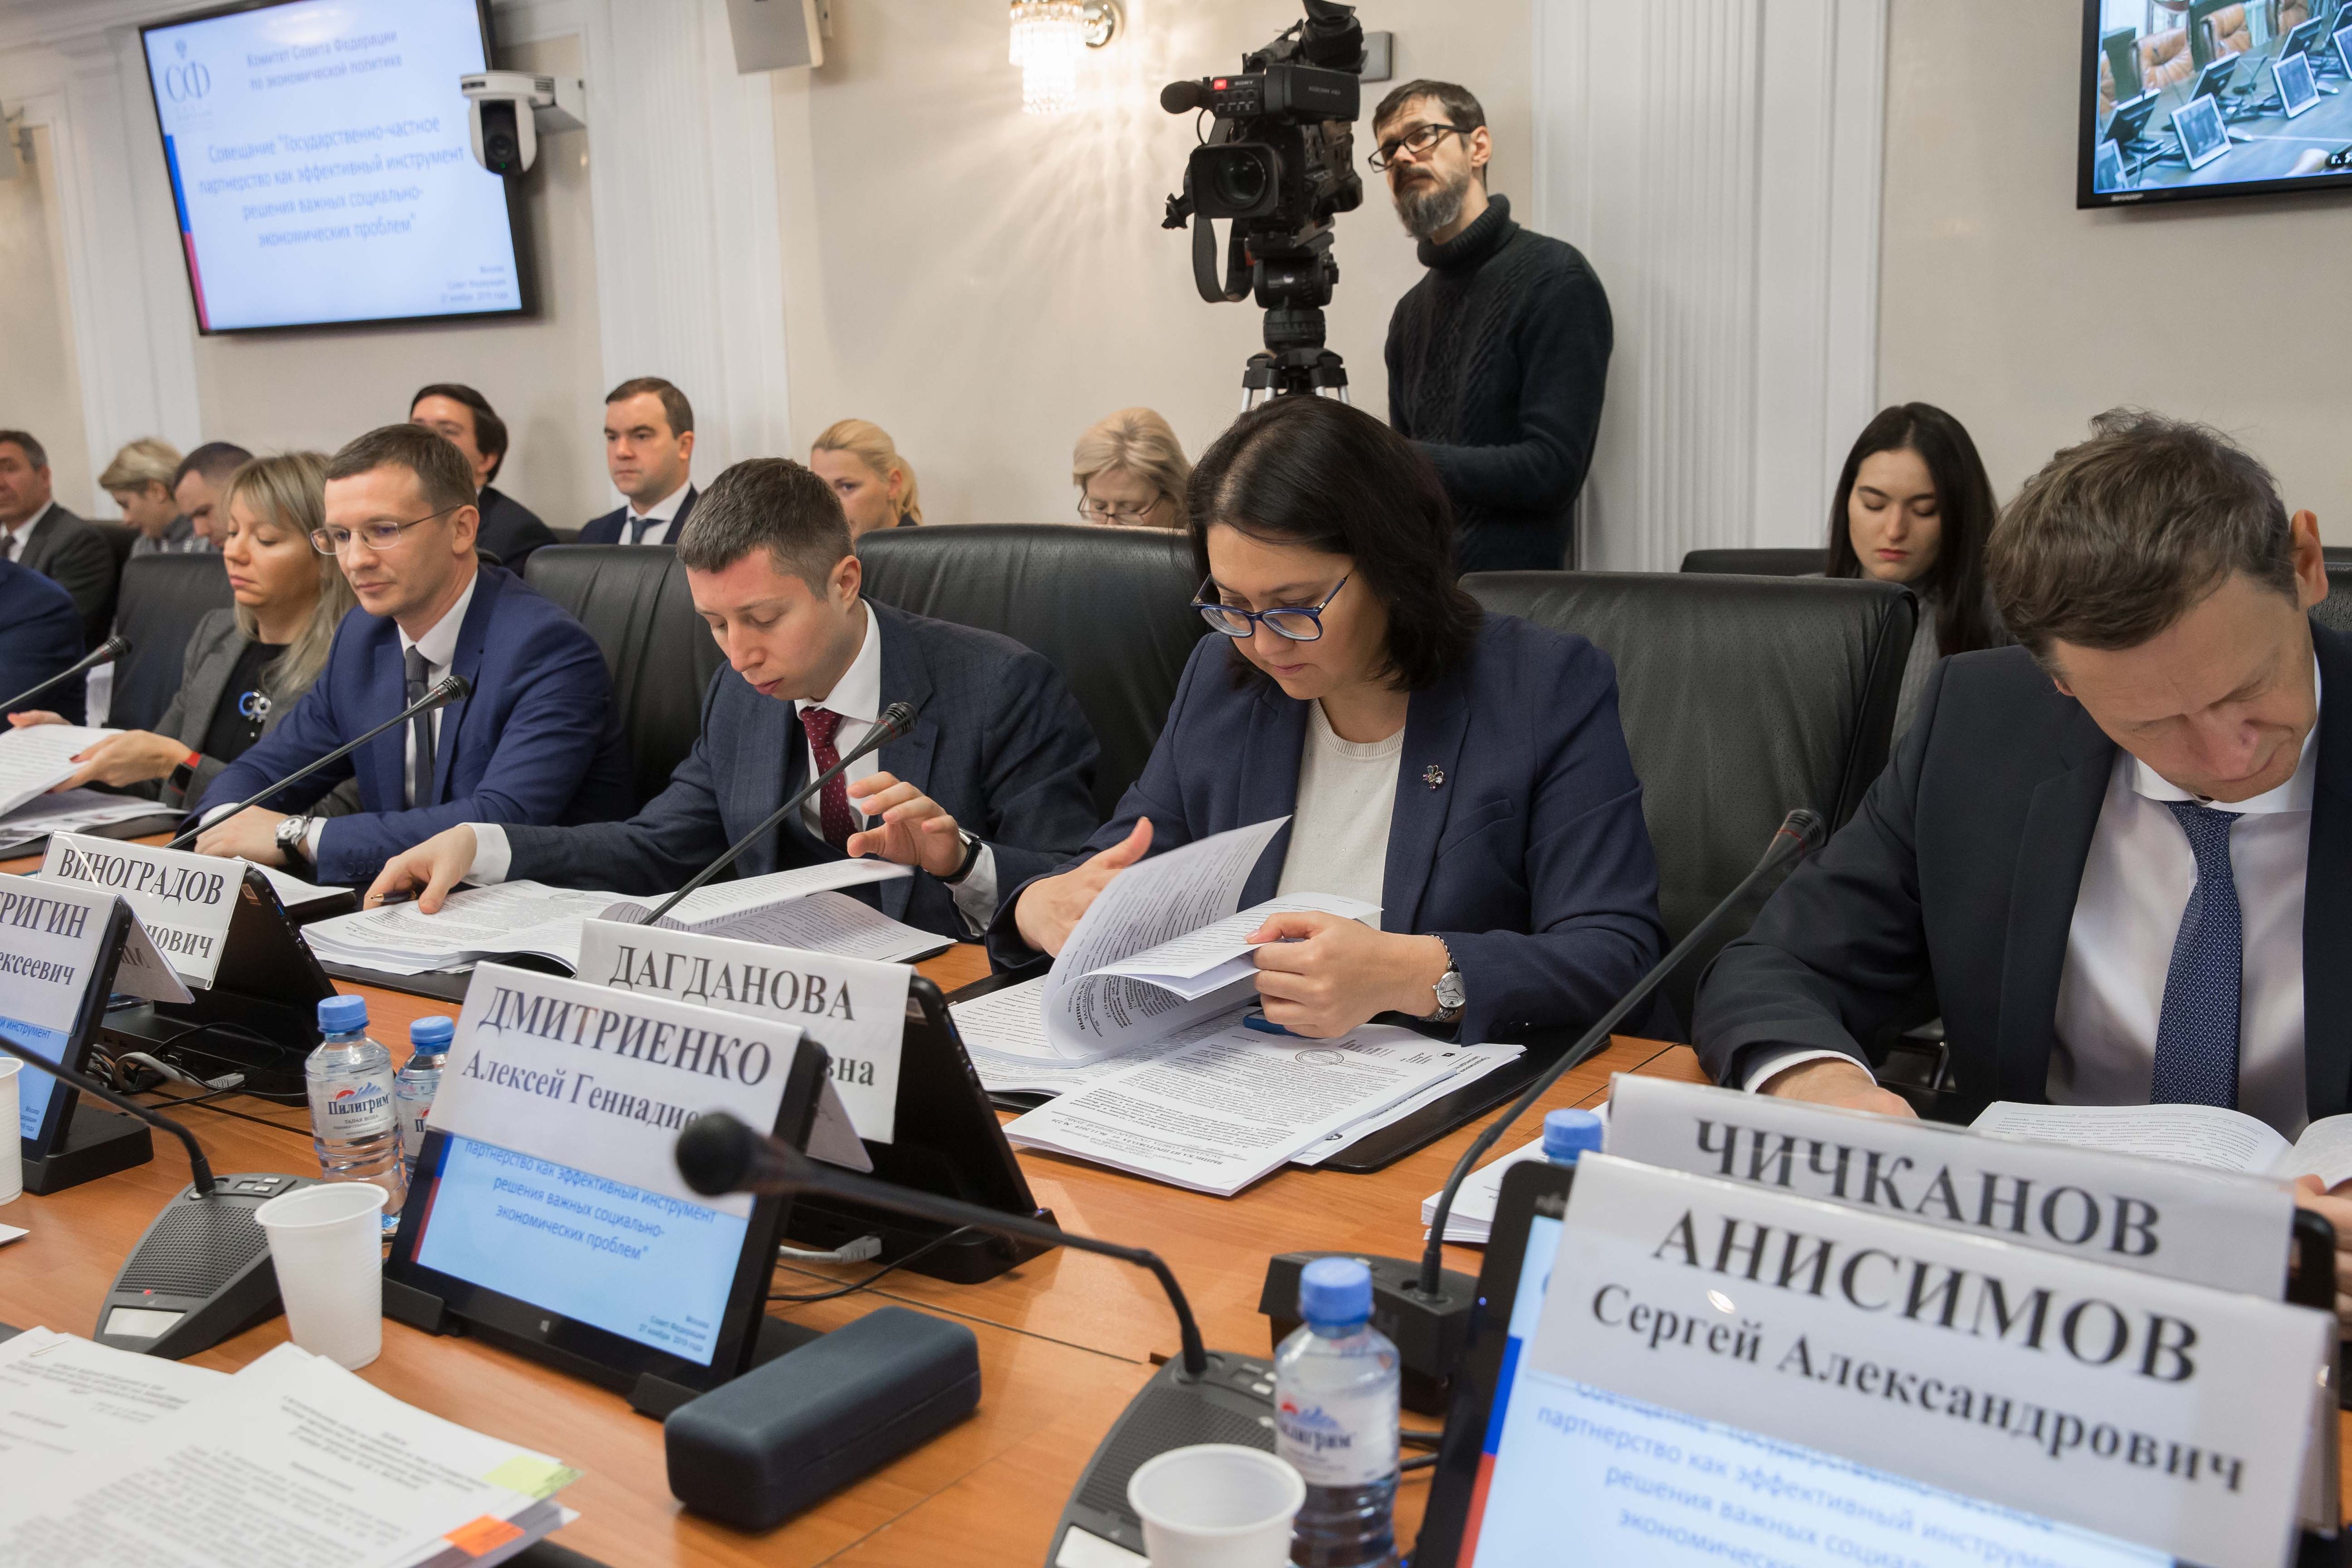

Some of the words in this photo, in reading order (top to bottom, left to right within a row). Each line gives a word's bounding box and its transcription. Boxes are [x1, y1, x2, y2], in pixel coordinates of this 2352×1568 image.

[267, 63, 348, 89] экономической
[199, 172, 272, 195] партнерство
[275, 168, 295, 183] как
[298, 154, 384, 183] эффективный
[387, 147, 464, 171] инструмент
[207, 141, 276, 163] Совещание
[242, 199, 296, 221] решения
[300, 195, 347, 214] важных
[259, 226, 351, 247] экономических
[57, 848, 225, 907] ВИНОГРАДОВ
[0, 891, 92, 939] РИГИН
[146, 924, 215, 958] нович
[609, 945, 856, 1022] ДАГДАНОВА
[7, 1023, 52, 1039] инструмент
[477, 987, 772, 1087] ДМИТРИЕНКО
[328, 1095, 389, 1115] Пилигрим
[461, 1048, 566, 1100] Алексей
[569, 1075, 699, 1130] Геннадие
[465, 1141, 533, 1171] партнерство
[536, 1162, 555, 1178] как
[557, 1165, 639, 1202] эффективный
[641, 1192, 716, 1224] инструмент
[493, 1177, 544, 1202] решения
[547, 1192, 592, 1217] важных
[594, 1207, 665, 1238] социально-
[1696, 1117, 2161, 1259] ЧИЧКАНОВ
[496, 1205, 584, 1242] экономических
[587, 1232, 648, 1261] проблем"
[1652, 1208, 2199, 1385] АНИСИМОВ
[1592, 1281, 1764, 1365] Сергей
[1777, 1332, 2249, 1495] Александрович
[1536, 1404, 1683, 1465] партнерство
[1687, 1452, 1728, 1478] как
[1736, 1463, 1915, 1535] эффективный
[1922, 1519, 2084, 1568] инструм
[1604, 1465, 1712, 1512] решения
[1720, 1500, 1817, 1545] важных
[1618, 1508, 1809, 1568] экономическ
